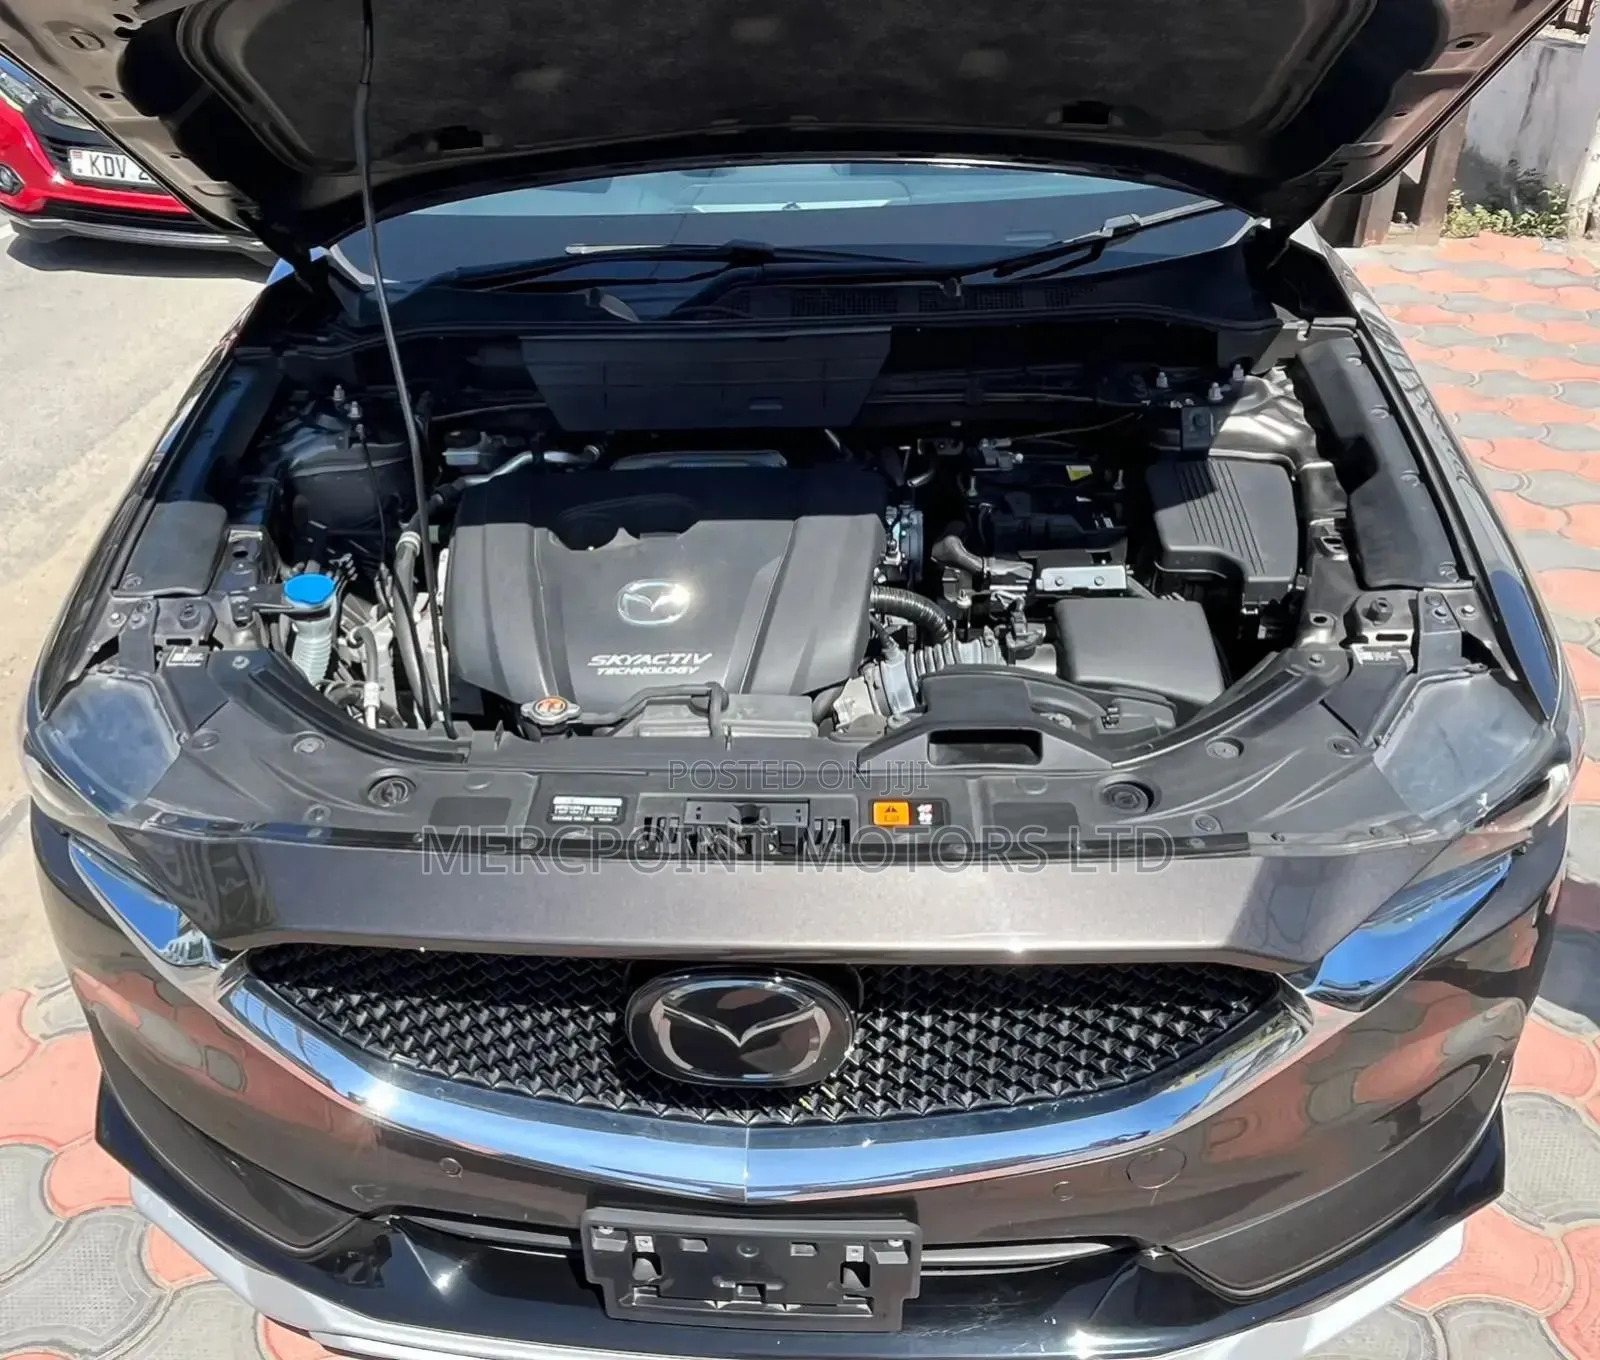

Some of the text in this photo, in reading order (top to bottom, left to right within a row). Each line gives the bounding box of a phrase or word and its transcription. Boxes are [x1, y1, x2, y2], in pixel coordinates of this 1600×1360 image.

[89, 154, 127, 178] KDV
[587, 653, 713, 666] SKYACTIV
[597, 666, 700, 676] TECHNOLOGY
